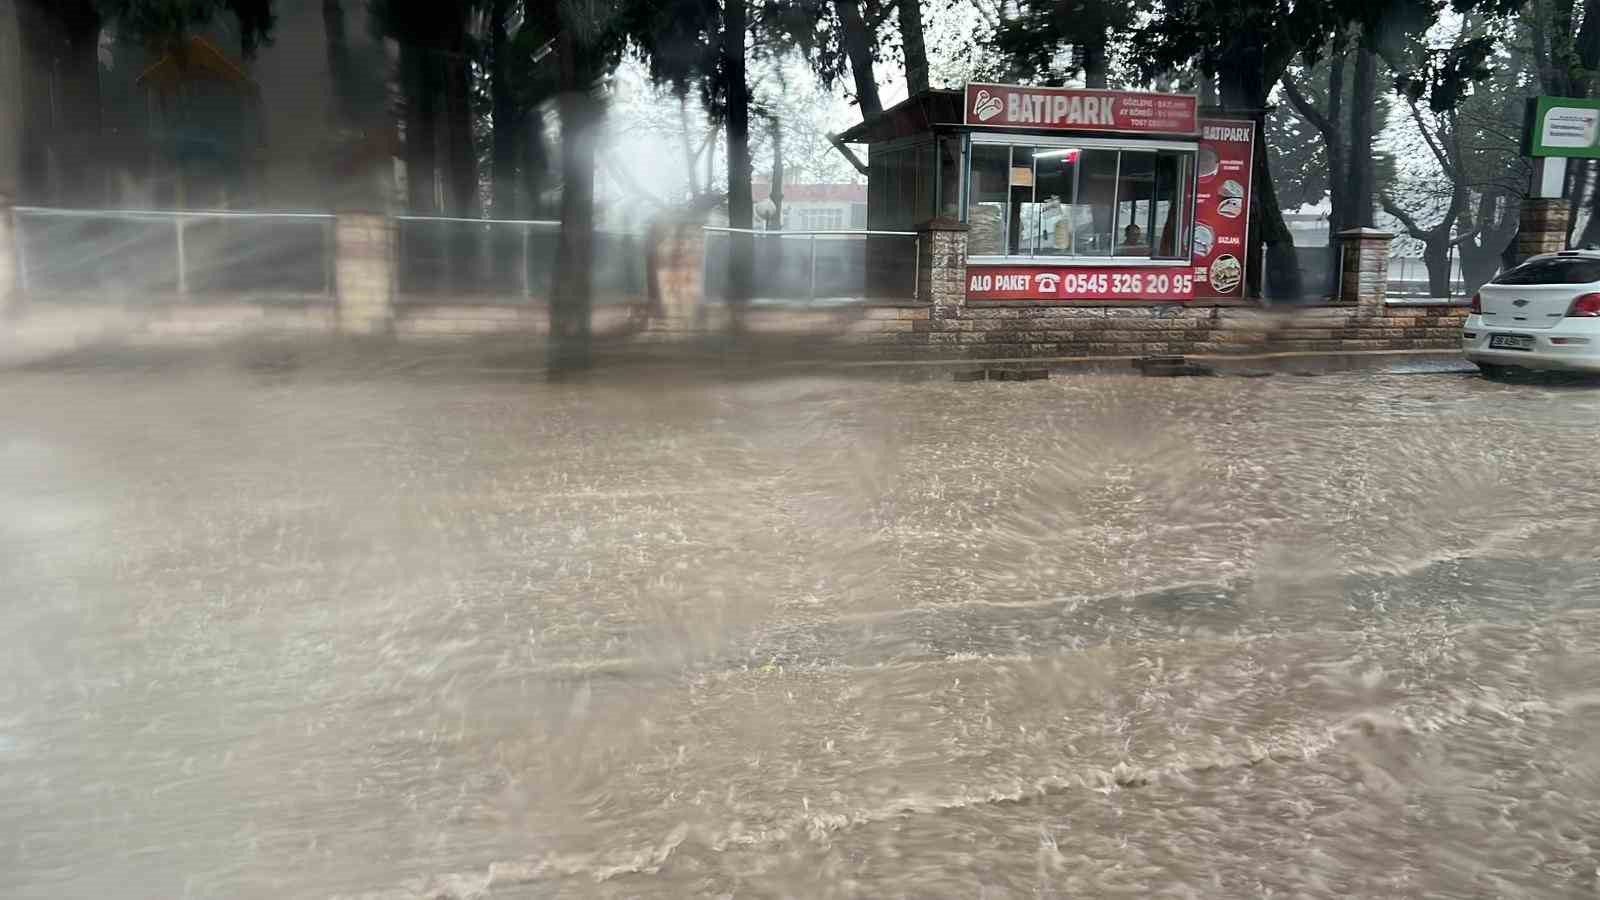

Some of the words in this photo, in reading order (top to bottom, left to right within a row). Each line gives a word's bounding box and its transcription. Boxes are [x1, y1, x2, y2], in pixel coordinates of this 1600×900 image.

[1007, 92, 1115, 125] BATIPARK
[1202, 126, 1250, 141] BATIPARK
[970, 275, 992, 291] ALO
[995, 275, 1031, 291] PAKET
[1064, 274, 1108, 293] 0545
[1111, 274, 1142, 293] 326
[1145, 274, 1169, 293] 20
[1173, 274, 1193, 293] 95
